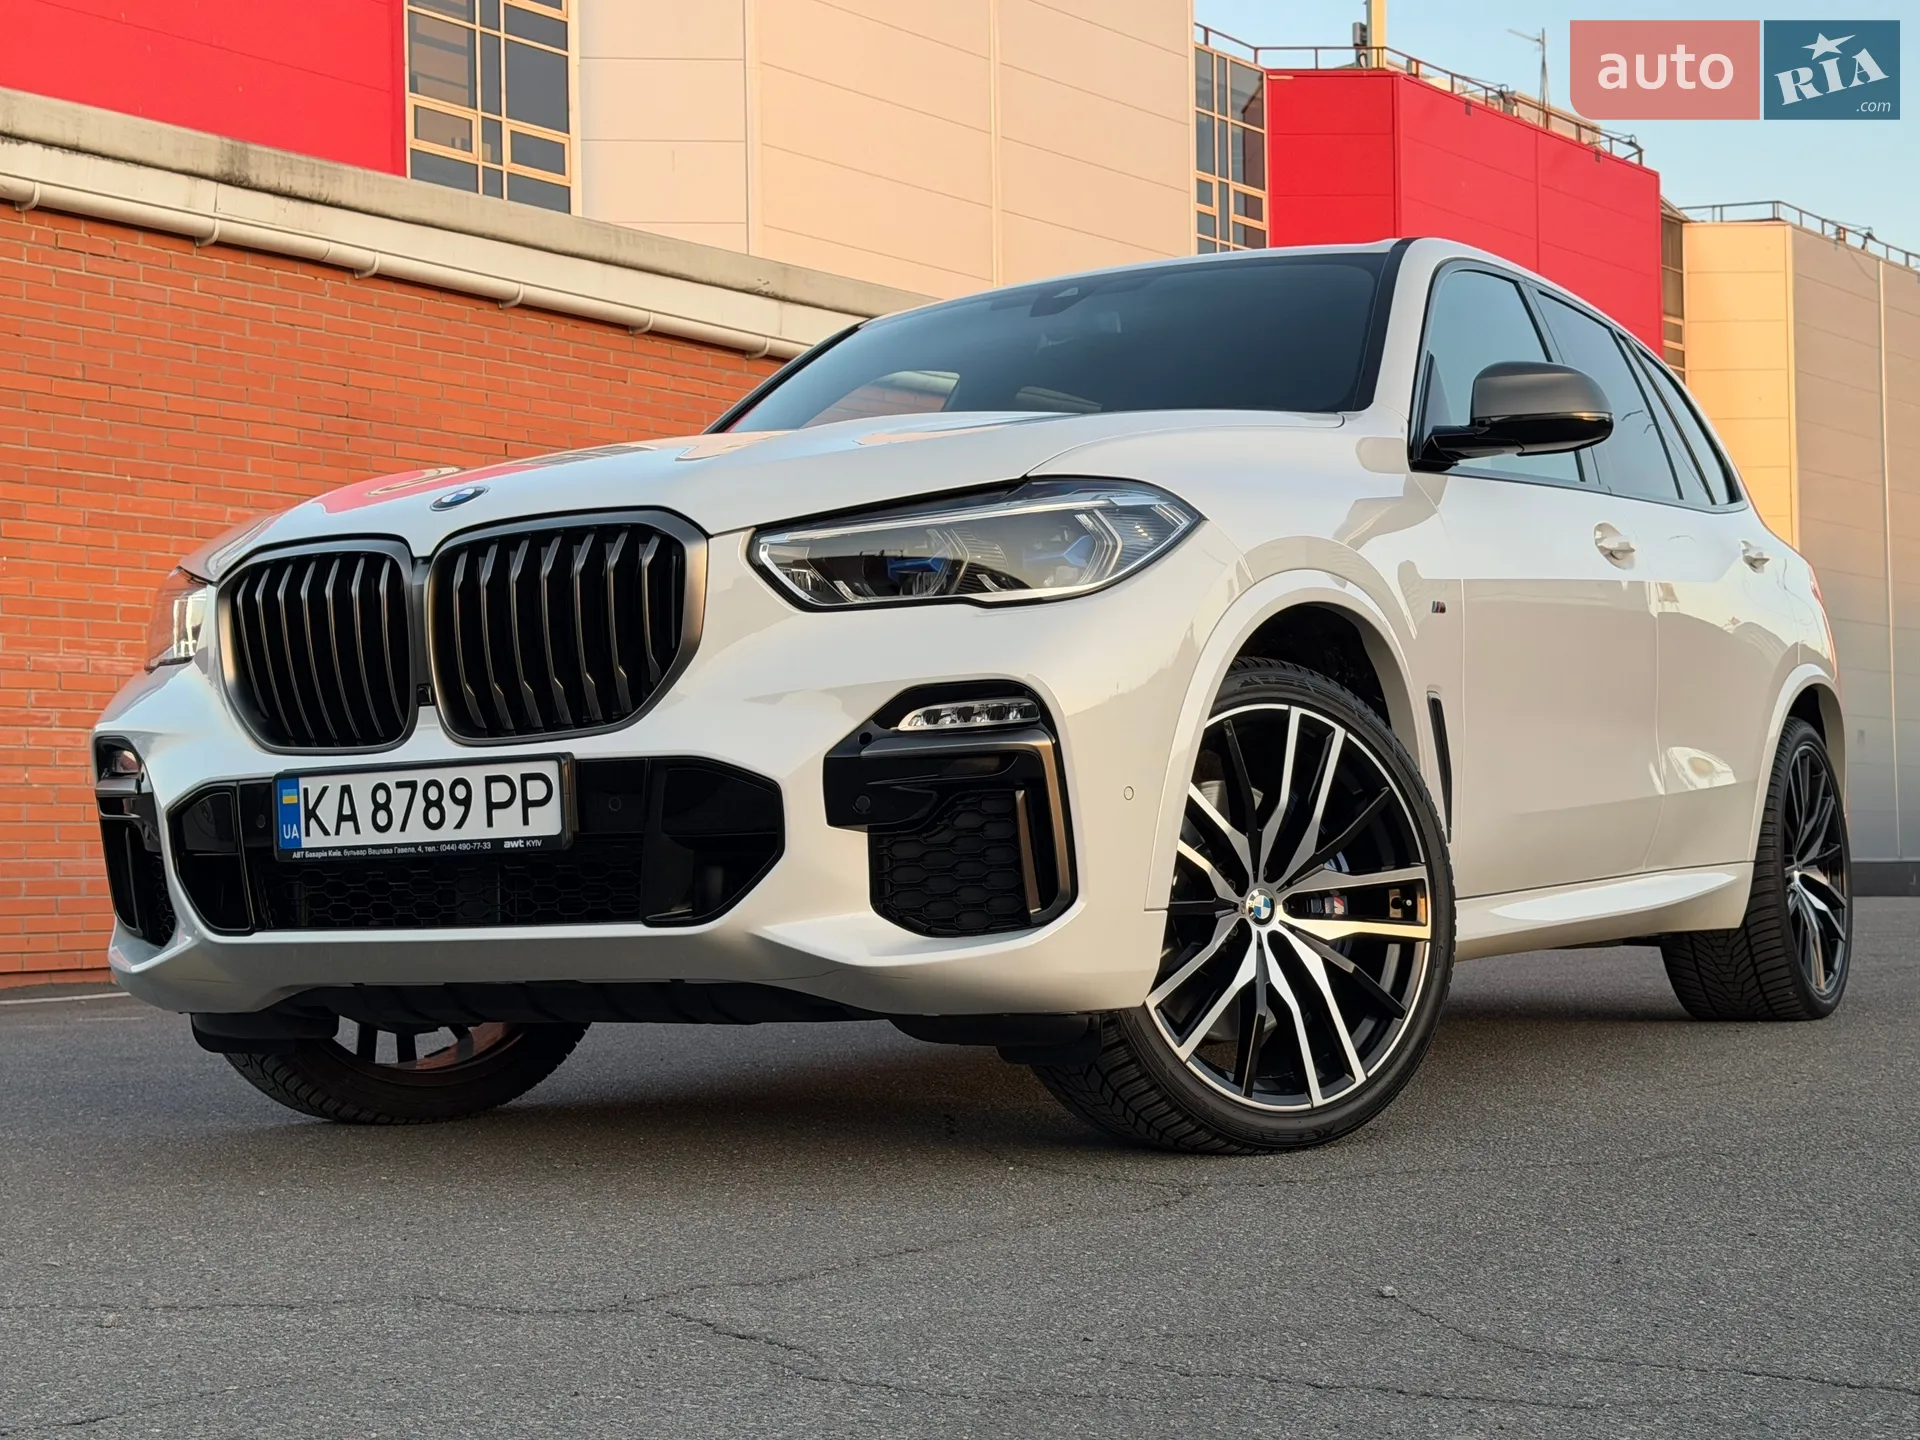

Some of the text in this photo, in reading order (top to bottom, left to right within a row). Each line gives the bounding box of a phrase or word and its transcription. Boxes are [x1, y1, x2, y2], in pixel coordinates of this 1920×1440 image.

[302, 772, 554, 838] KA 8789 PP
[282, 824, 300, 840] UA
[440, 843, 457, 852] (044)
[458, 841, 492, 850] 490-77-33
[503, 839, 543, 849] awt KYIV
